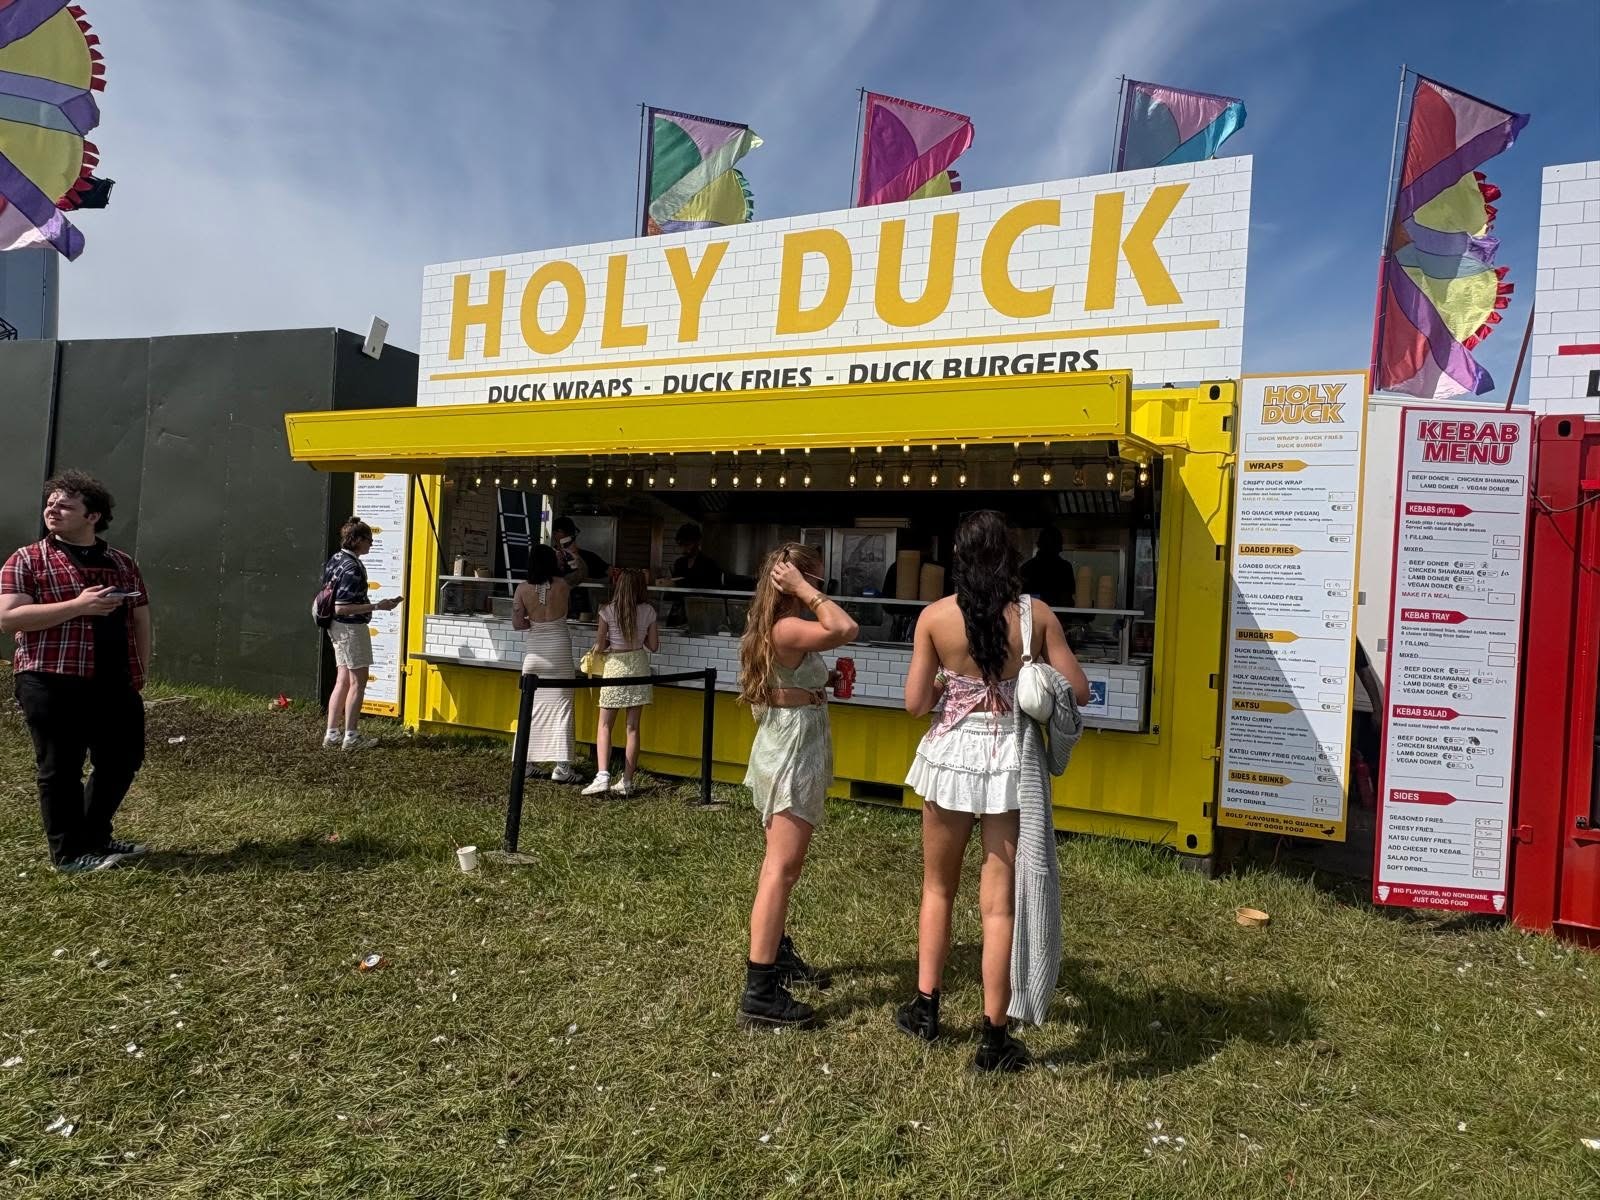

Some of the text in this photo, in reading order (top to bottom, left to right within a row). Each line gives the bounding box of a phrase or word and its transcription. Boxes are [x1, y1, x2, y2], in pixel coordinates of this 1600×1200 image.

[448, 184, 1190, 361] HOLY DUCK
[488, 383, 546, 404] DUCK
[553, 378, 633, 400] WRAPS
[662, 372, 734, 395] DUCK
[740, 366, 812, 390] FRIES
[849, 360, 934, 384] DUCK
[942, 350, 1099, 378] BURGERS
[1264, 383, 1347, 405] HOLY
[1261, 403, 1346, 424] DUCK
[1417, 419, 1520, 444] KEBAB
[1422, 441, 1512, 465] MENU
[1409, 505, 1455, 515] KEBABS (PITTA)
[1404, 611, 1429, 620] KEBAB
[1423, 709, 1447, 718] SALAD
[1259, 775, 1284, 784] DRINKS
[1393, 791, 1420, 800] SIDES
